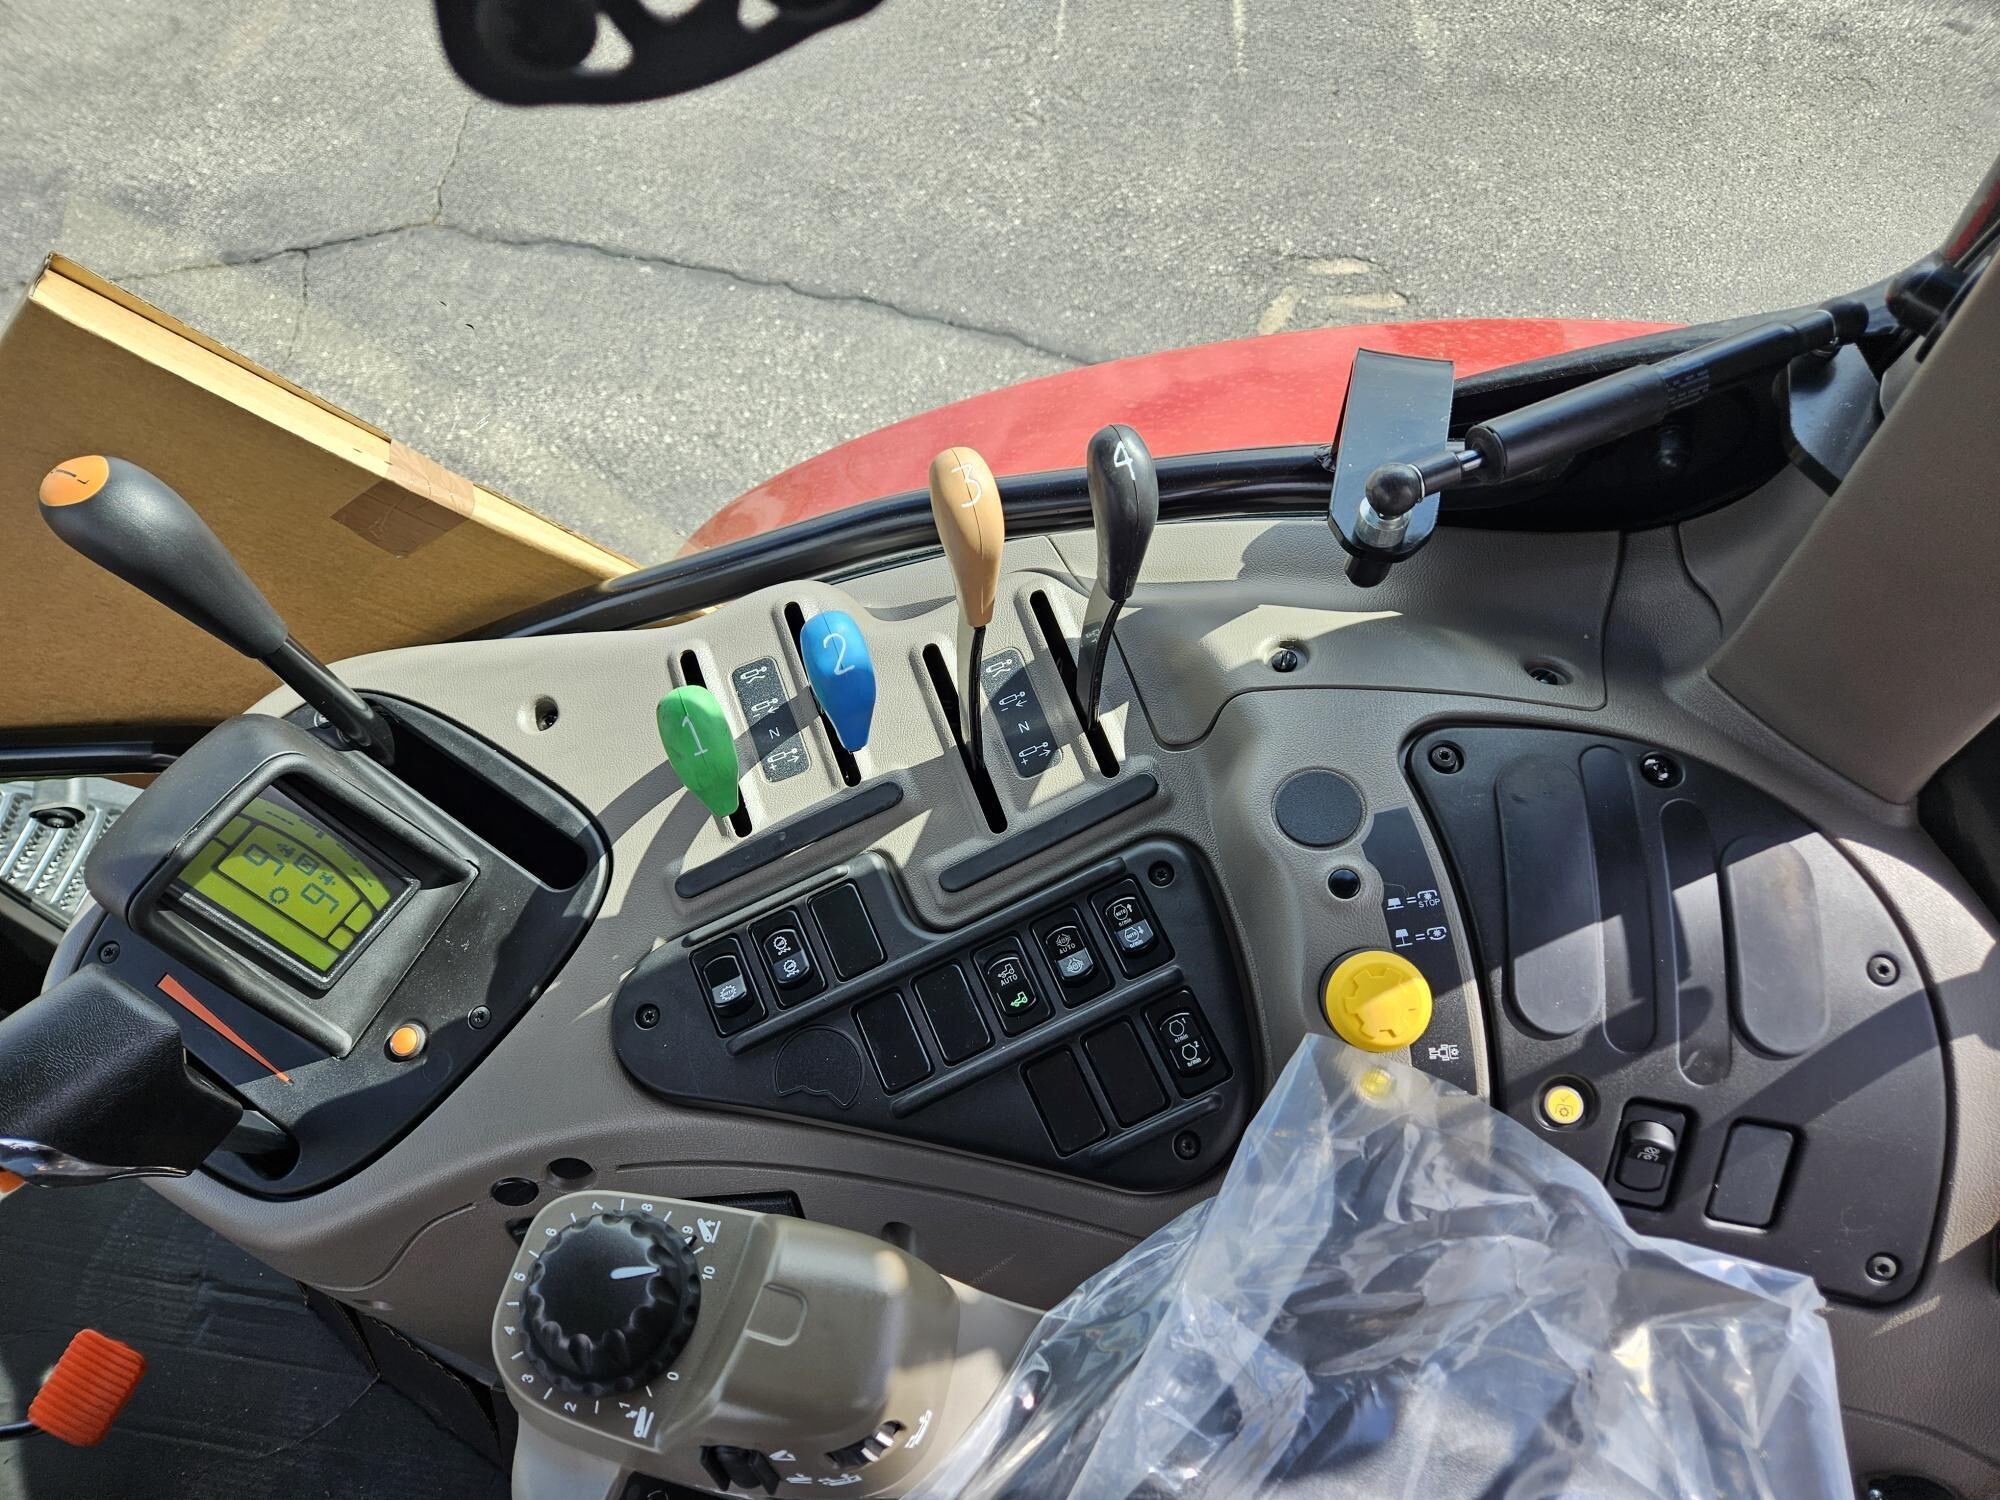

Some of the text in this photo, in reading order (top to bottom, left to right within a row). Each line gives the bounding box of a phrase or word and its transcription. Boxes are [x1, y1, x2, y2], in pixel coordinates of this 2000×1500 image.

[1113, 440, 1136, 481] 4
[951, 463, 983, 509] 3
[823, 633, 855, 676] 2
[1018, 721, 1030, 733] N
[682, 716, 708, 756] 1
[769, 727, 780, 740] N
[1418, 898, 1440, 908] STOP
[1059, 943, 1076, 954] AUTO
[1000, 974, 1018, 986] AUTO
[592, 1202, 603, 1211] 7
[641, 1203, 653, 1212] 8
[545, 1227, 557, 1237] 6
[681, 1225, 694, 1235] 9
[513, 1272, 526, 1282] 5
[702, 1266, 716, 1281] 10
[504, 1326, 516, 1336] 4
[521, 1374, 534, 1384] 3
[667, 1371, 679, 1381] 0
[564, 1402, 577, 1413] 2
